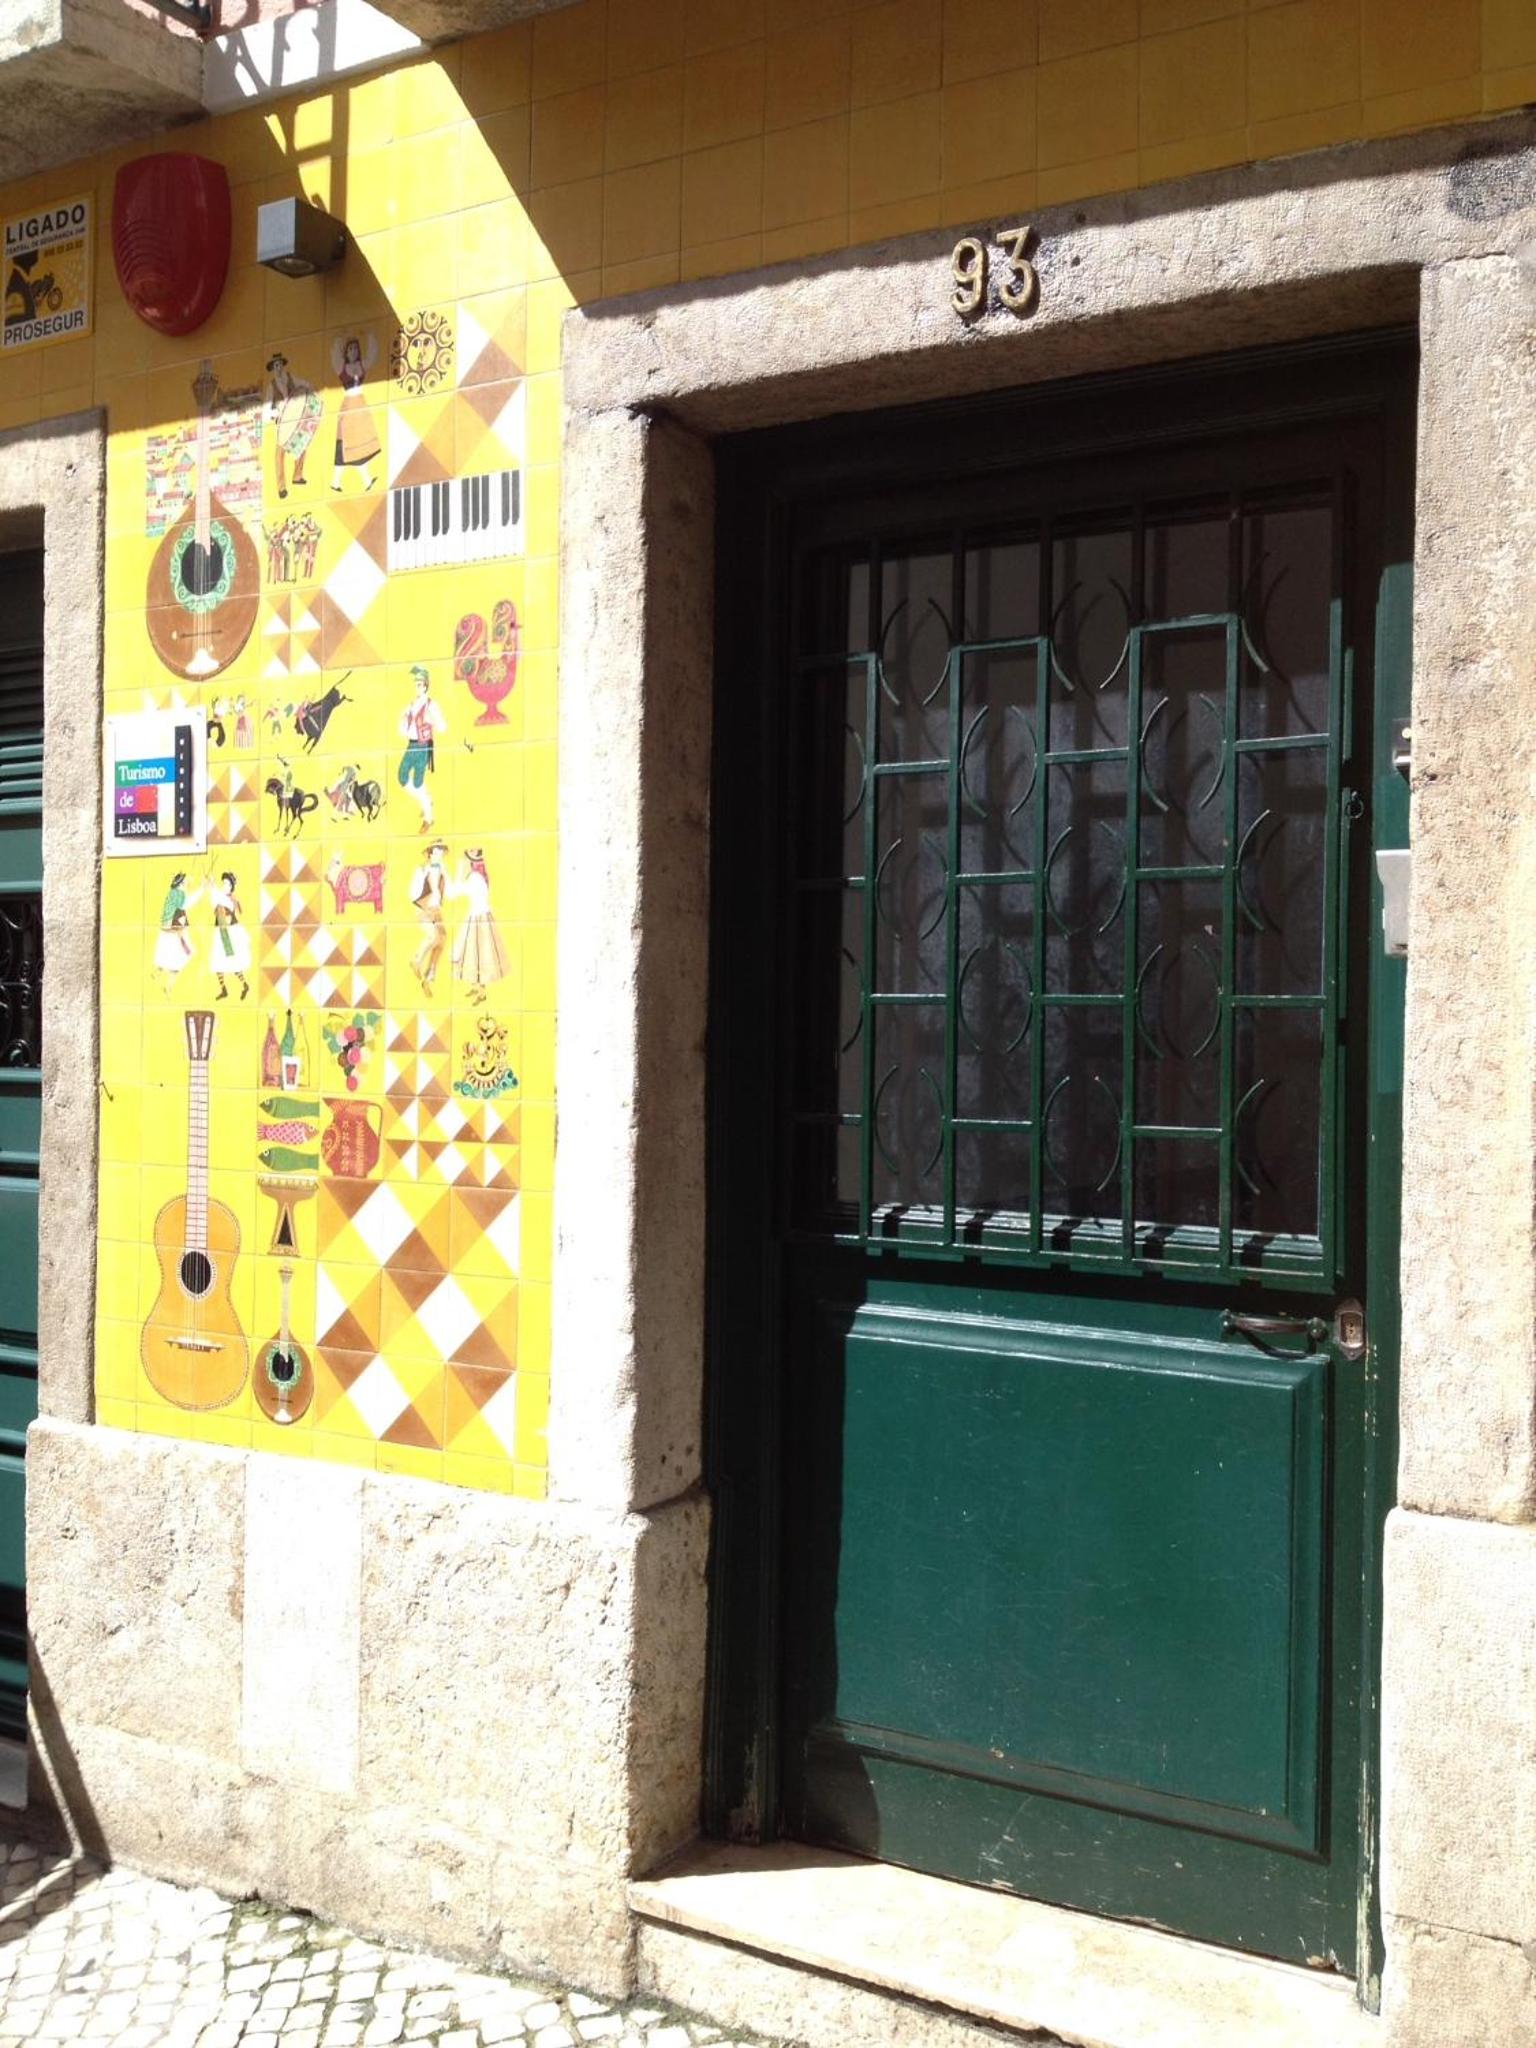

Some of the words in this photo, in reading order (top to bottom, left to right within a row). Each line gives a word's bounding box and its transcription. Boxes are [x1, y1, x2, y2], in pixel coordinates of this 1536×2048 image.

[5, 203, 85, 245] LIGADO
[951, 225, 1034, 313] 93
[3, 309, 85, 346] PROSEGUR
[118, 764, 166, 781] Turismo
[119, 792, 134, 808] de
[118, 815, 157, 834] Lisboa
